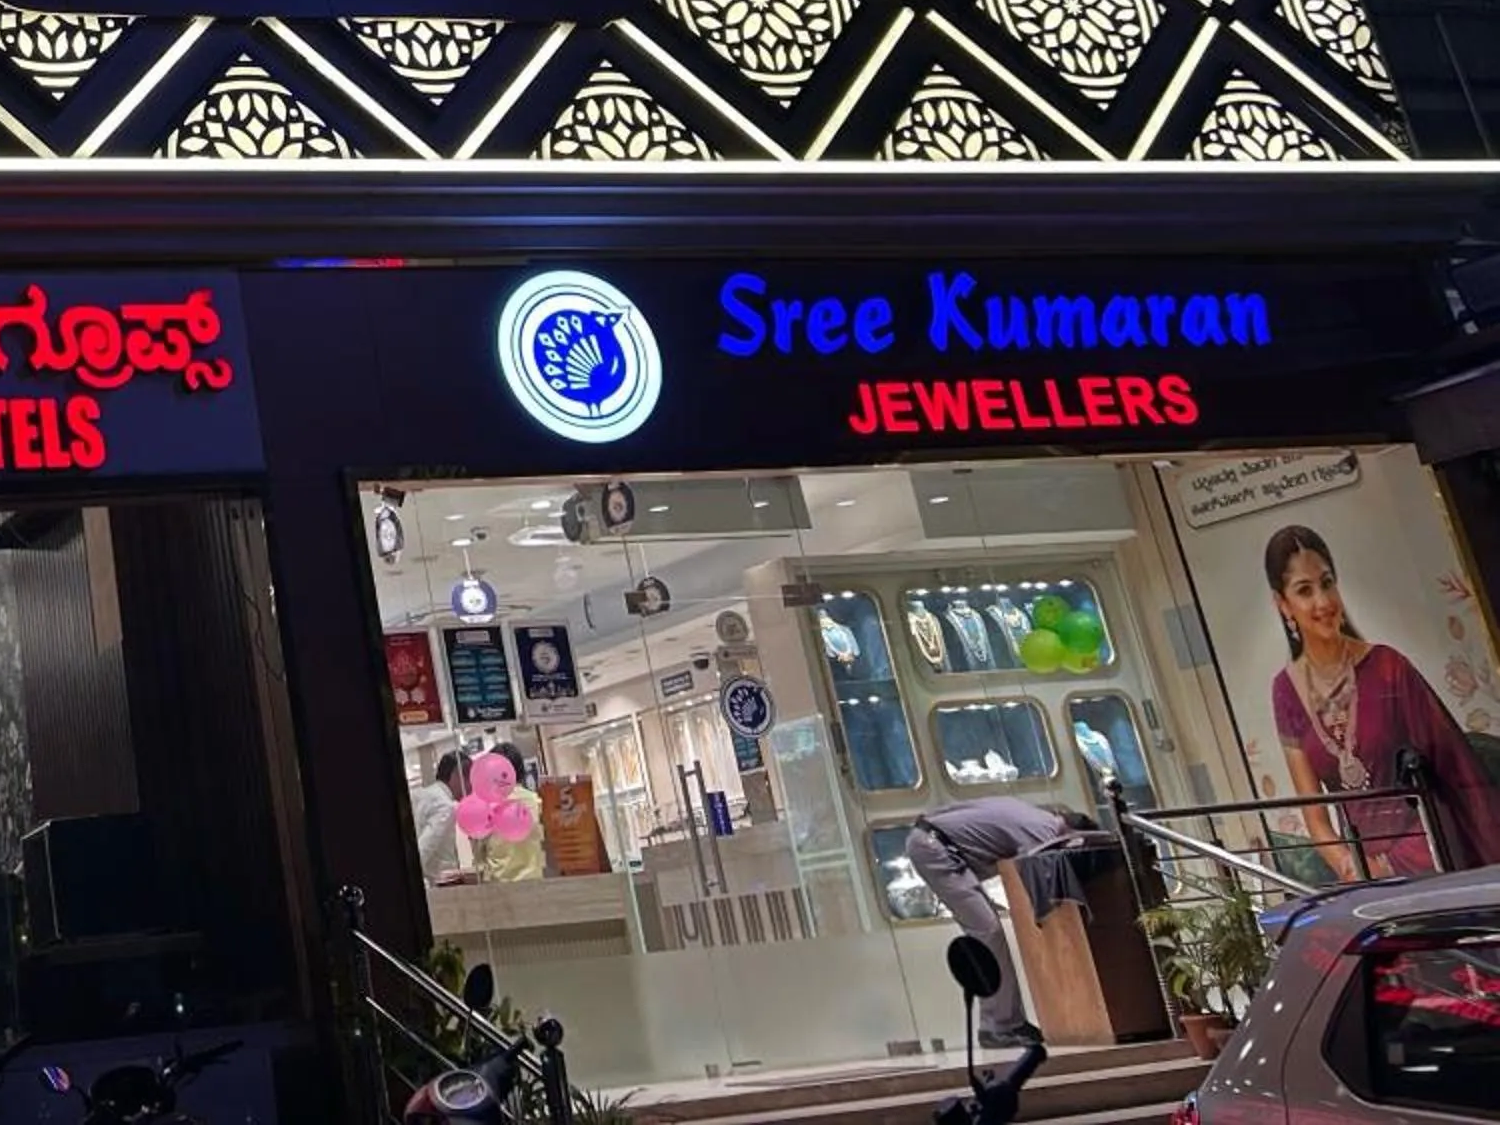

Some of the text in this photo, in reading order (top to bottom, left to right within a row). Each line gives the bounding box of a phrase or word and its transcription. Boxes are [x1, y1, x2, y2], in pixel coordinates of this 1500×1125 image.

[717, 271, 1272, 357] Sree Kumaran
[849, 375, 1198, 434] JEWELLERS
